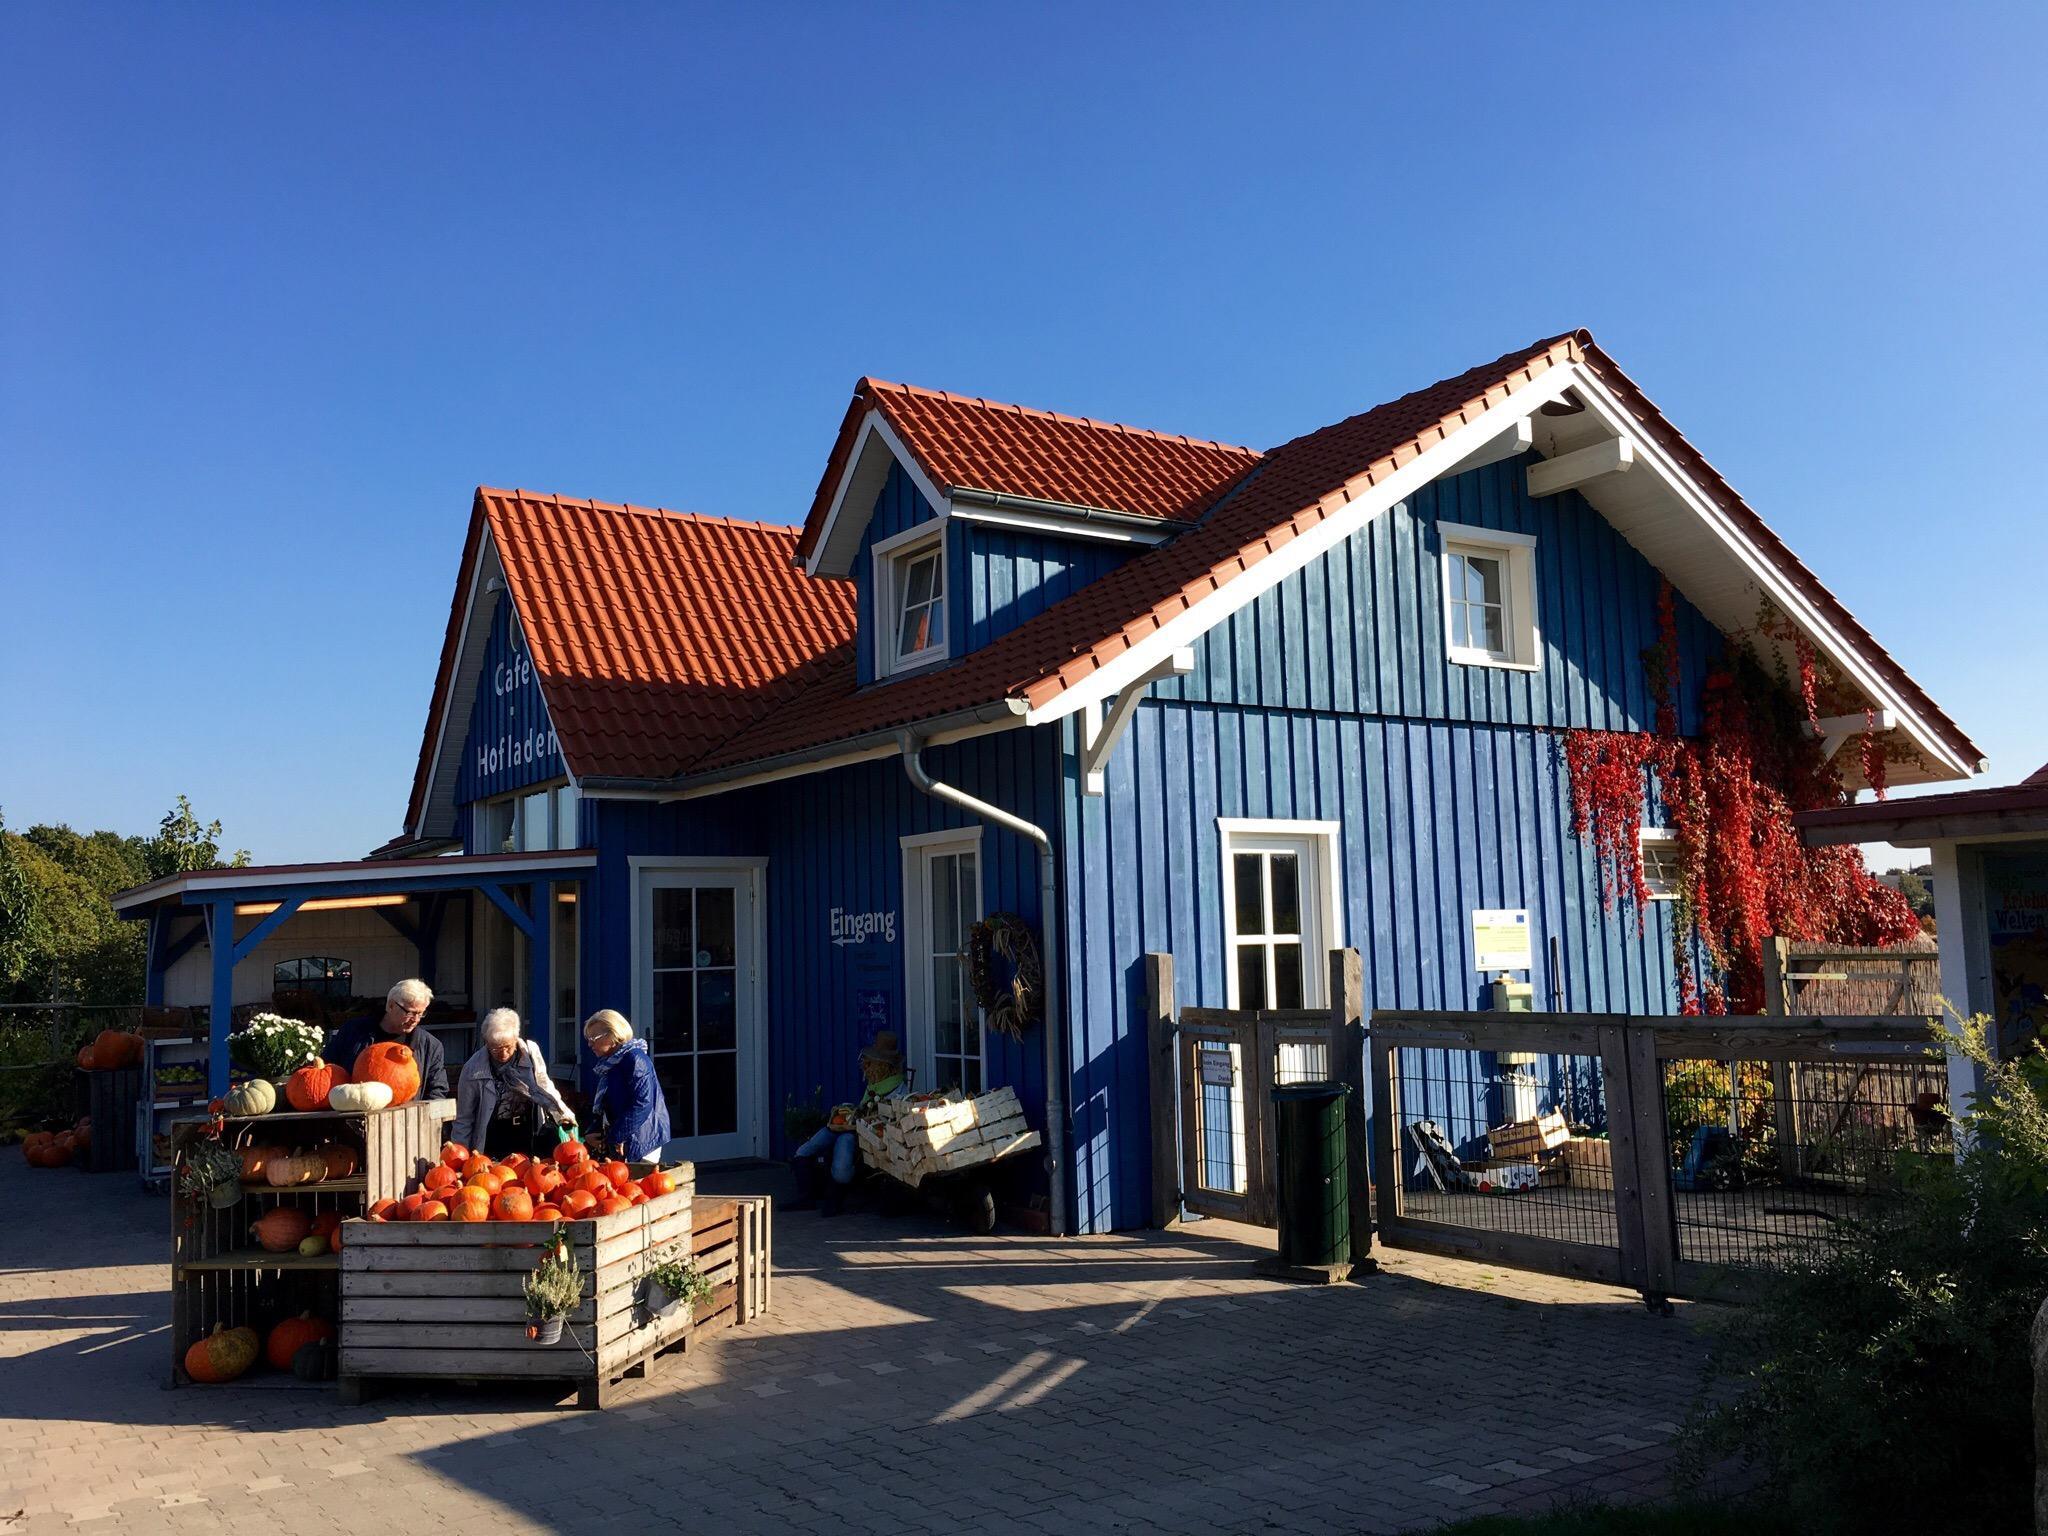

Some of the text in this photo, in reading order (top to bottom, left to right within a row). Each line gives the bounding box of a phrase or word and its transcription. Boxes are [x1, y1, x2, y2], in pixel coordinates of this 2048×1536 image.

[494, 654, 530, 695] Cafe
[477, 727, 560, 778] Hofladen
[830, 907, 896, 943] Eingang
[1995, 910, 2045, 930] Welten
